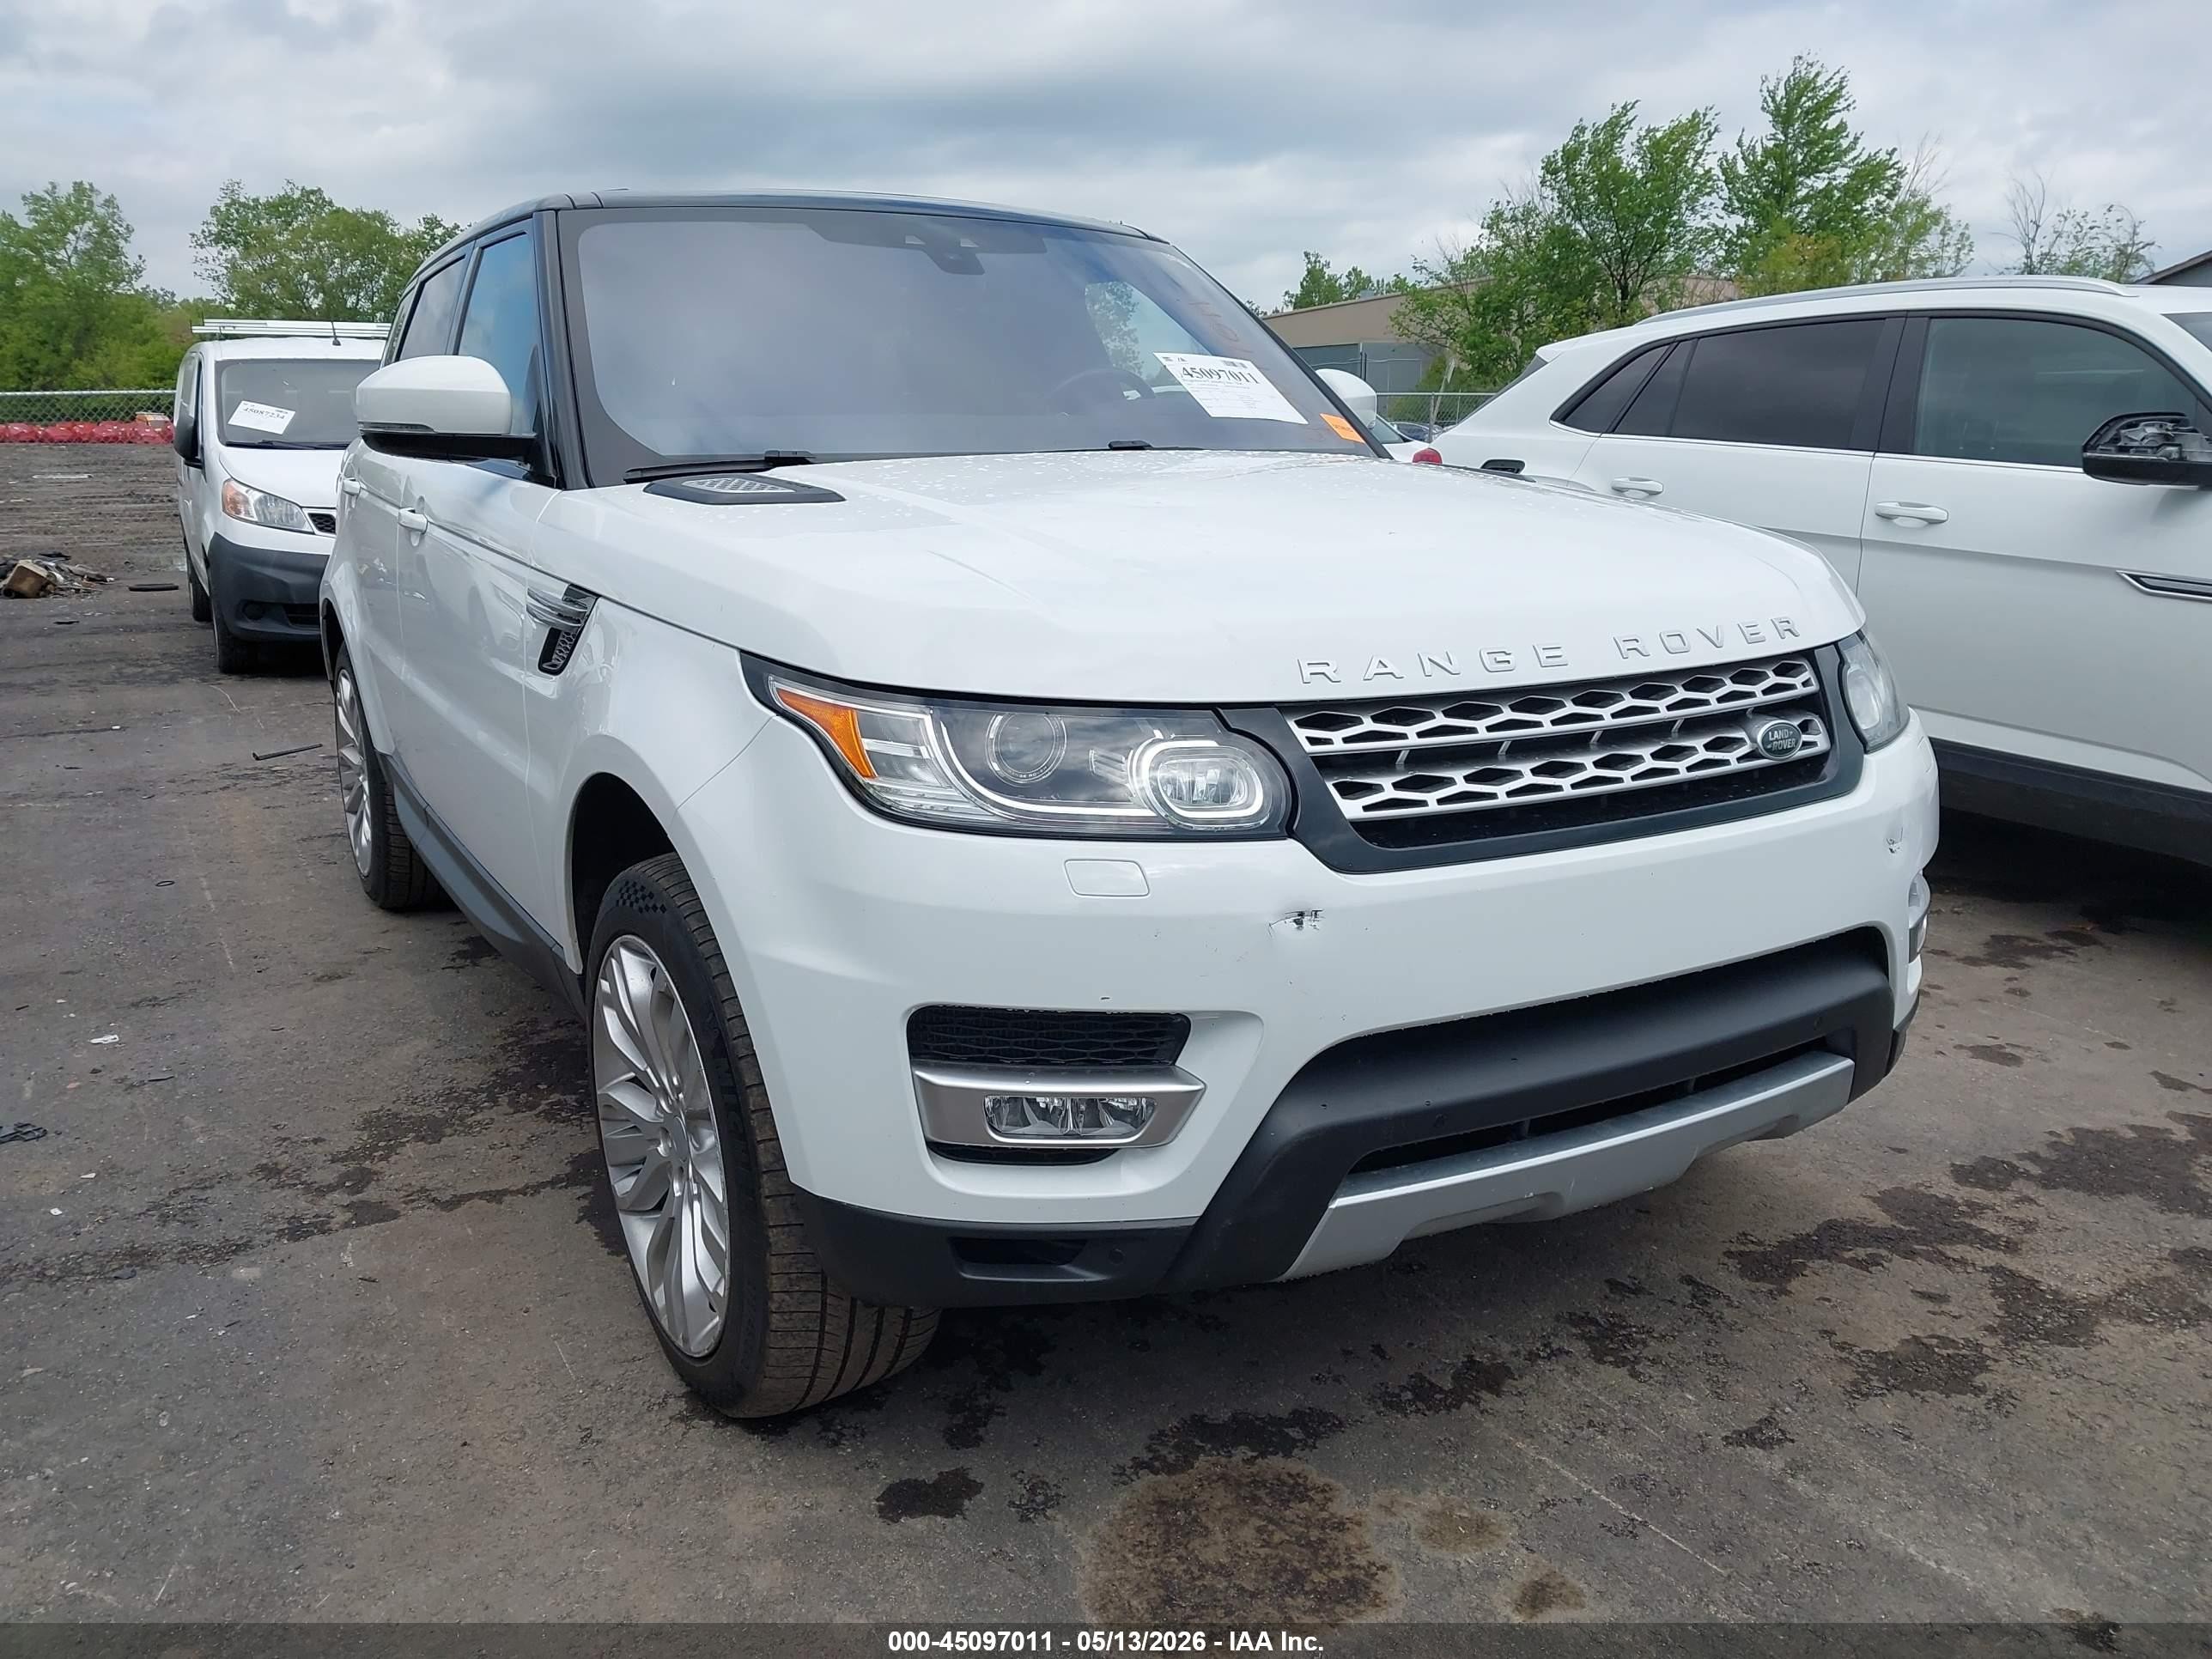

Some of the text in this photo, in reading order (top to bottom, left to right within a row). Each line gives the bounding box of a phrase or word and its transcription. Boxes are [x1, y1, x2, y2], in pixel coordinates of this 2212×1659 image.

[1182, 366, 1260, 385] 45097011
[1297, 616, 1802, 684] RANGE ROVER
[1769, 729, 1789, 741] LAND
[1772, 738, 1796, 750] ROVER
